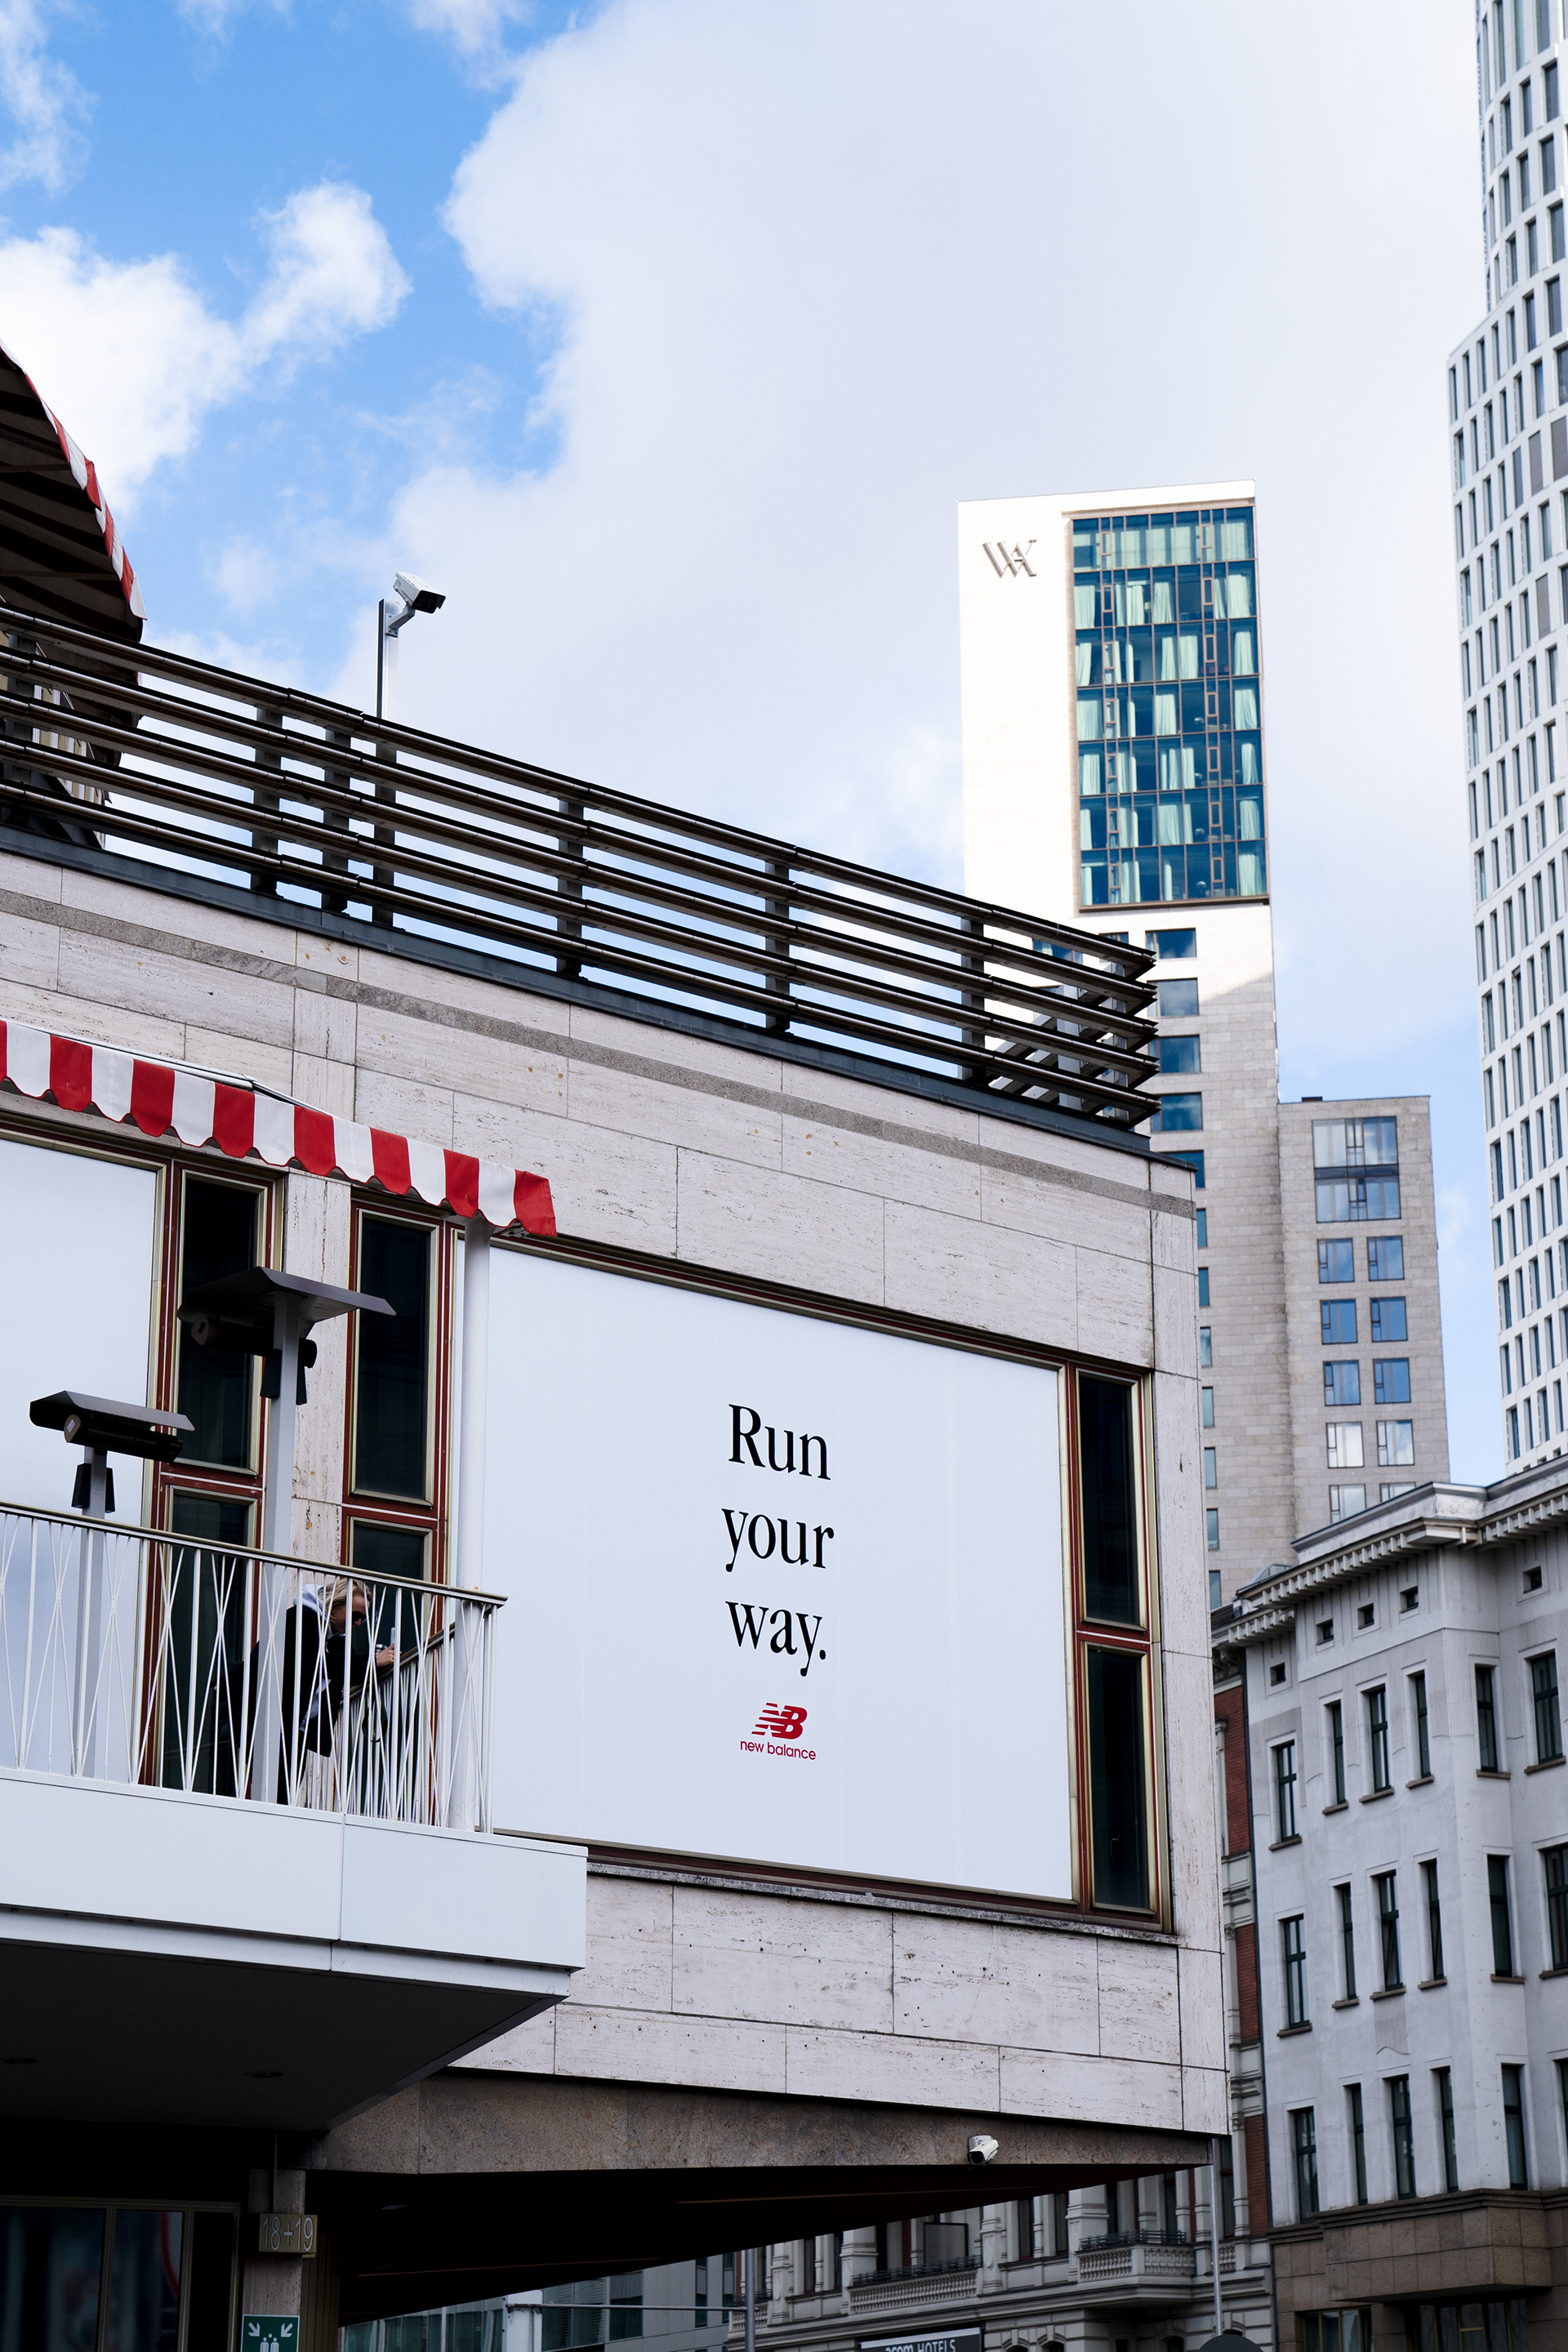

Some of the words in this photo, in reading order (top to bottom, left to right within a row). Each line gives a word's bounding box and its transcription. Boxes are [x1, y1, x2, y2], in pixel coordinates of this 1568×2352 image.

[728, 1403, 831, 1481] Run
[721, 1508, 835, 1573] your
[724, 1601, 826, 1677] way.
[740, 1740, 764, 1753] new
[767, 1741, 816, 1761] balance
[262, 2216, 314, 2252] 18+19
[917, 2339, 956, 2352] HOTELS
